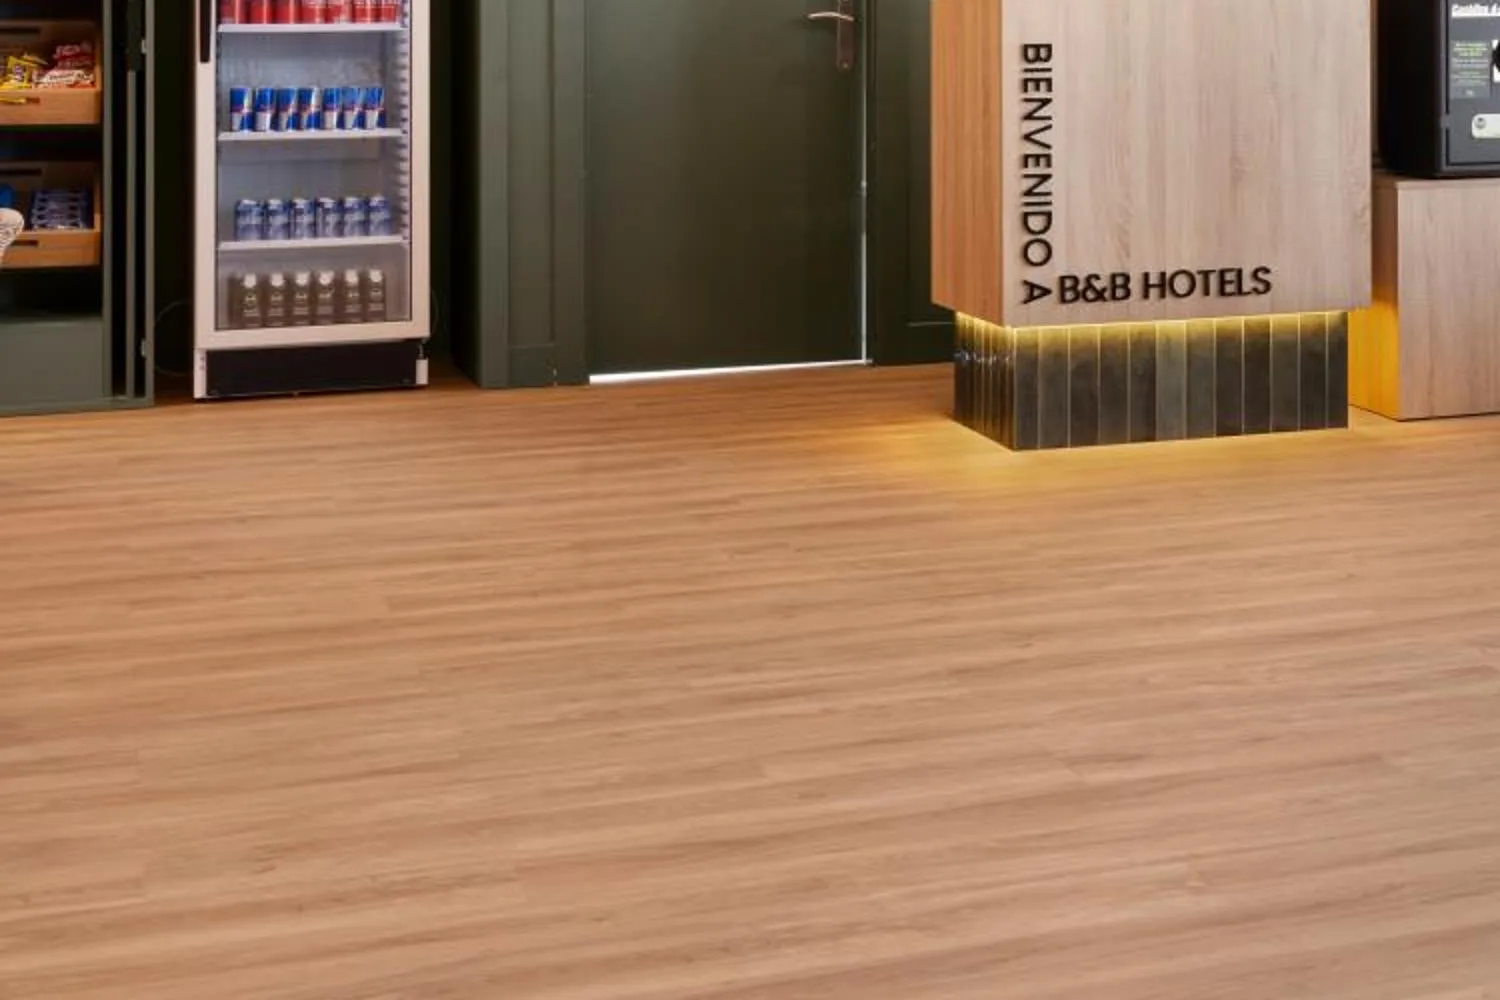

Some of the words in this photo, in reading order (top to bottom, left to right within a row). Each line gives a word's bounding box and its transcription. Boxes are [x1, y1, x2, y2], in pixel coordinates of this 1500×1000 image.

[1021, 43, 1053, 267] BIENVENIDO
[1022, 279, 1053, 304] A
[1058, 273, 1132, 304] B&B
[1142, 266, 1272, 300] HOTELS
